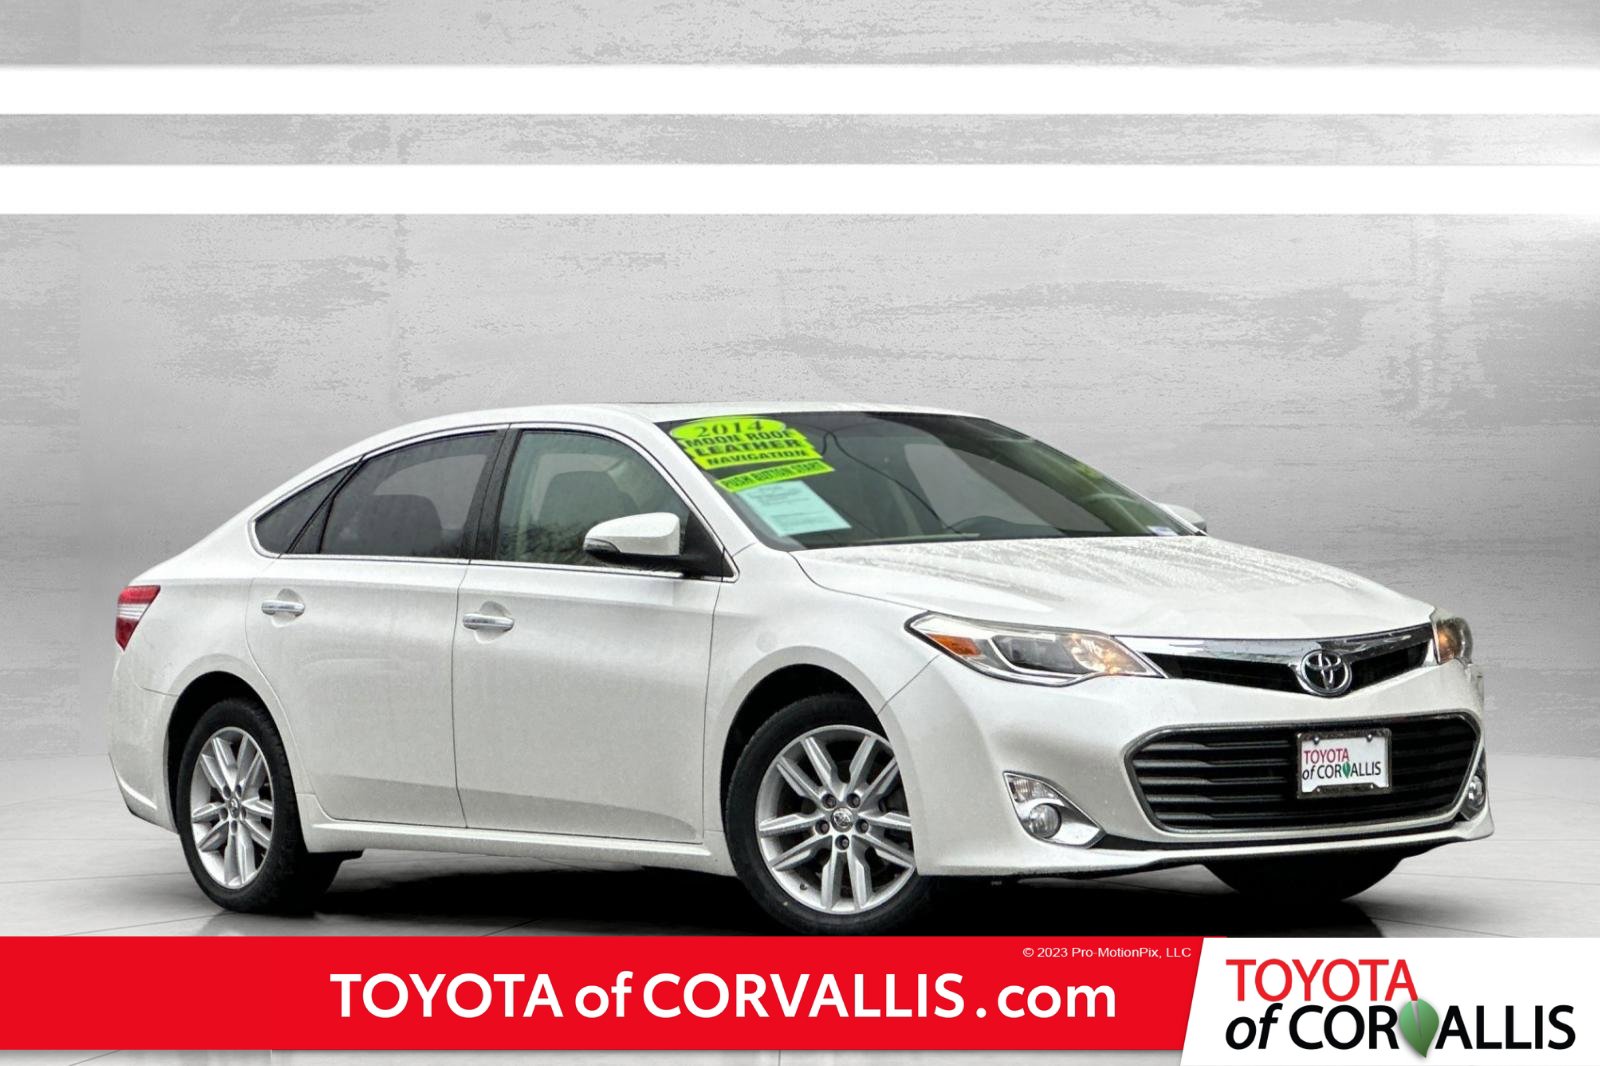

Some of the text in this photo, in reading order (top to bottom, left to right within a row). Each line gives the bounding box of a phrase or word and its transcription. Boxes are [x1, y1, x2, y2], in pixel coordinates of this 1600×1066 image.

[697, 420, 763, 437] 2014
[686, 429, 794, 448] MOON ROOF
[695, 439, 801, 457] LEATHER
[707, 450, 807, 466] NAVIGATION
[751, 465, 792, 480] BUTTON
[791, 461, 822, 474] START
[1303, 748, 1350, 764] TOYOTA
[1302, 765, 1316, 780] of
